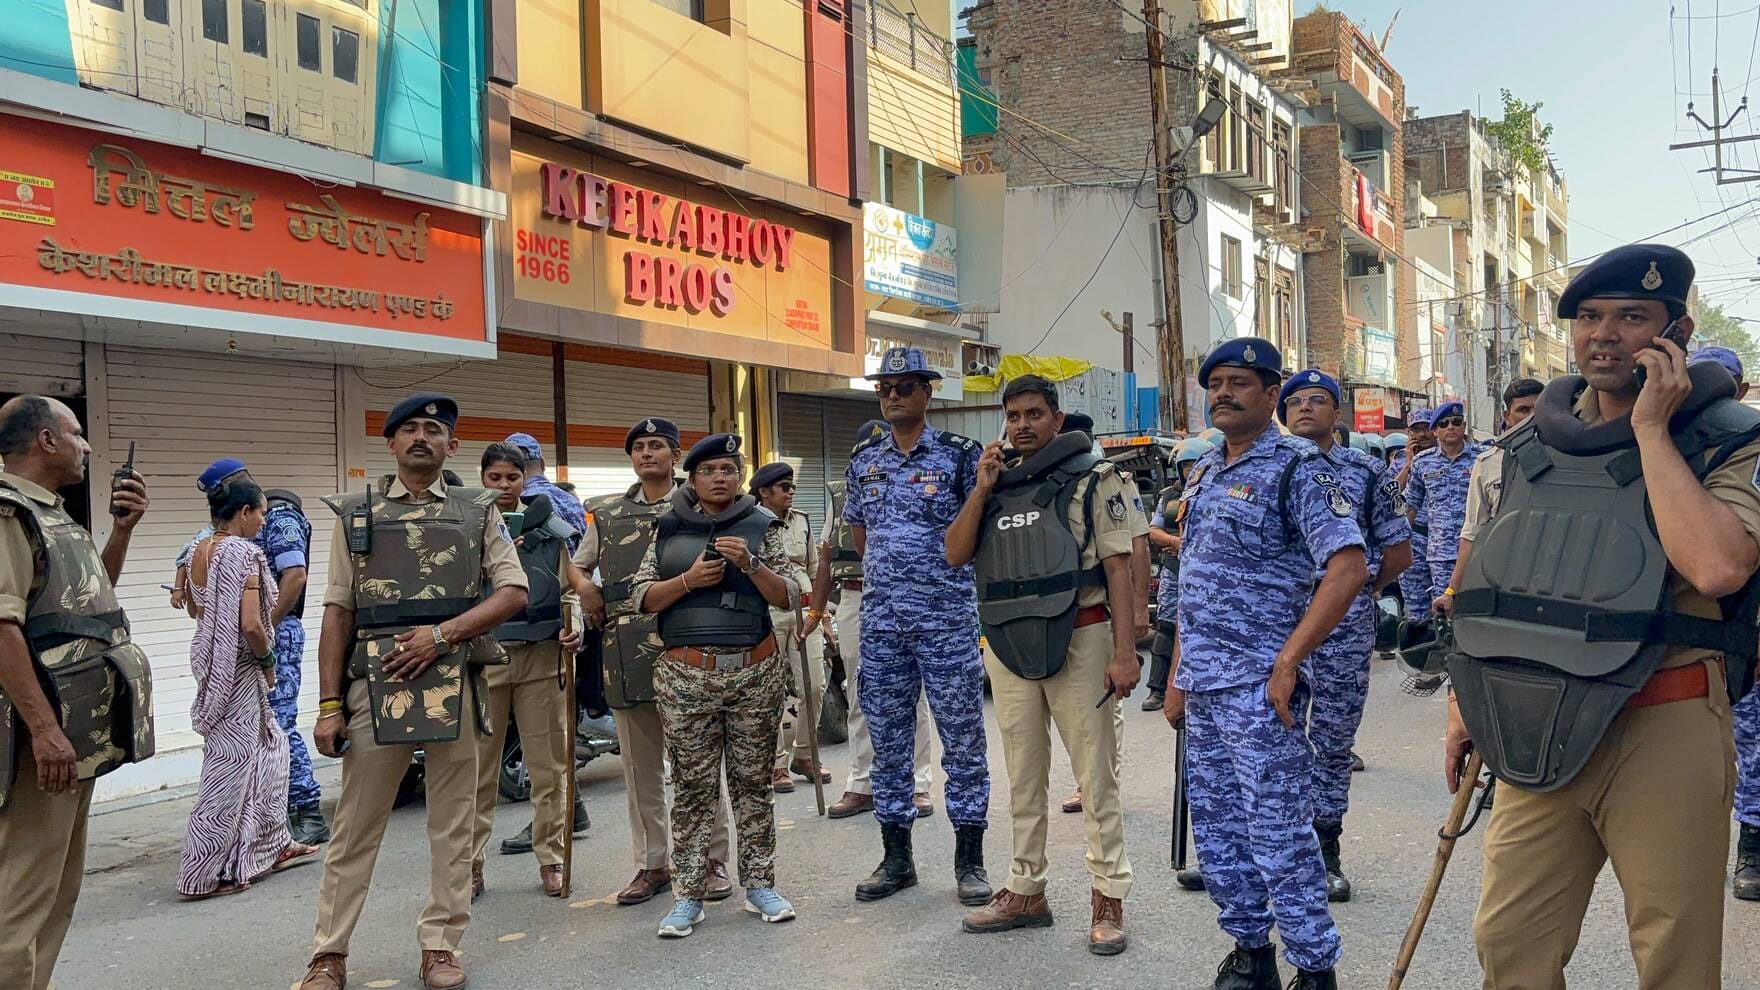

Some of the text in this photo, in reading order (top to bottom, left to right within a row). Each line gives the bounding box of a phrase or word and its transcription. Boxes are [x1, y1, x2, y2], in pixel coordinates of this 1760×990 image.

[88, 143, 431, 262] मित्तल ज्वेलर्स
[540, 162, 796, 273] KEEKABHOY
[516, 229, 570, 261] SINCE
[517, 255, 570, 285] 1966
[624, 251, 735, 317] BROS
[997, 511, 1041, 531] CSP
